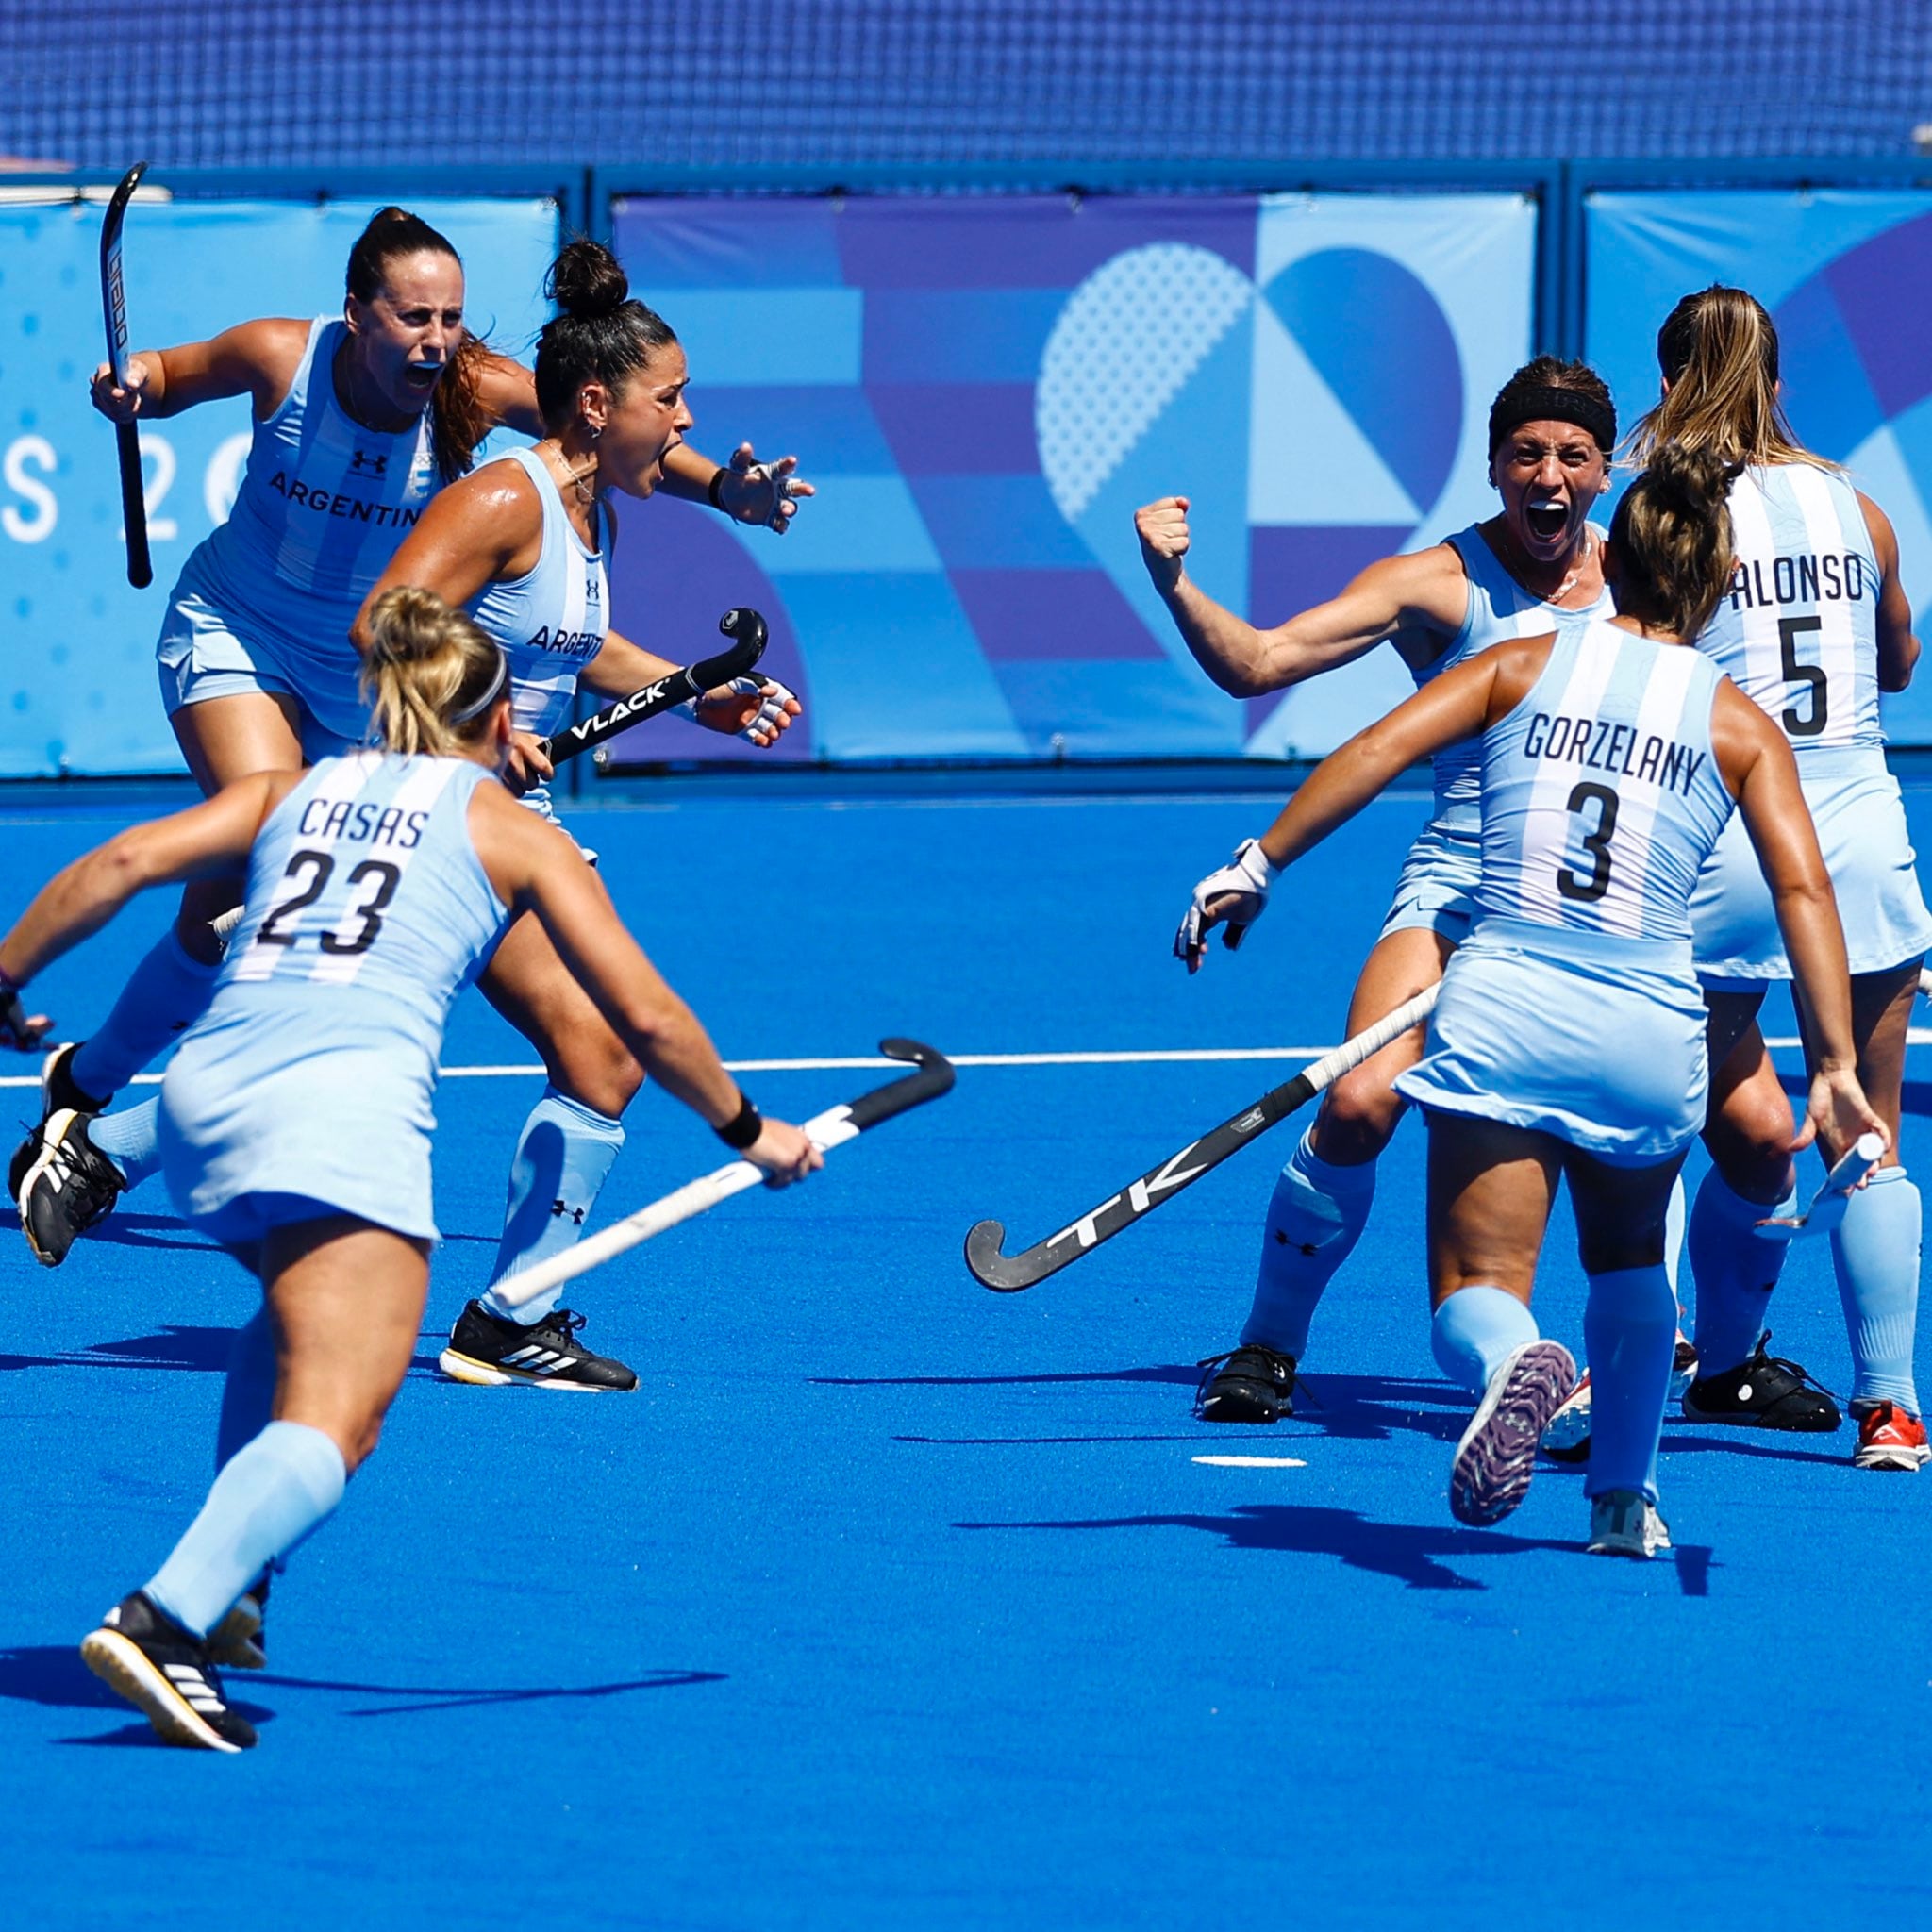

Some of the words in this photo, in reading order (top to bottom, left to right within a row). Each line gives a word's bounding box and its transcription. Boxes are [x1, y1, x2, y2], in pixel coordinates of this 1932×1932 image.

[1730, 554, 1862, 610] ALONSO
[571, 679, 666, 741] VLACK
[1777, 615, 1828, 737] 5
[1524, 712, 1707, 797] GORZELANY
[298, 798, 430, 849] CASAS
[1557, 781, 1620, 903] 3
[257, 849, 401, 955] 23
[1046, 1139, 1209, 1247] TK
